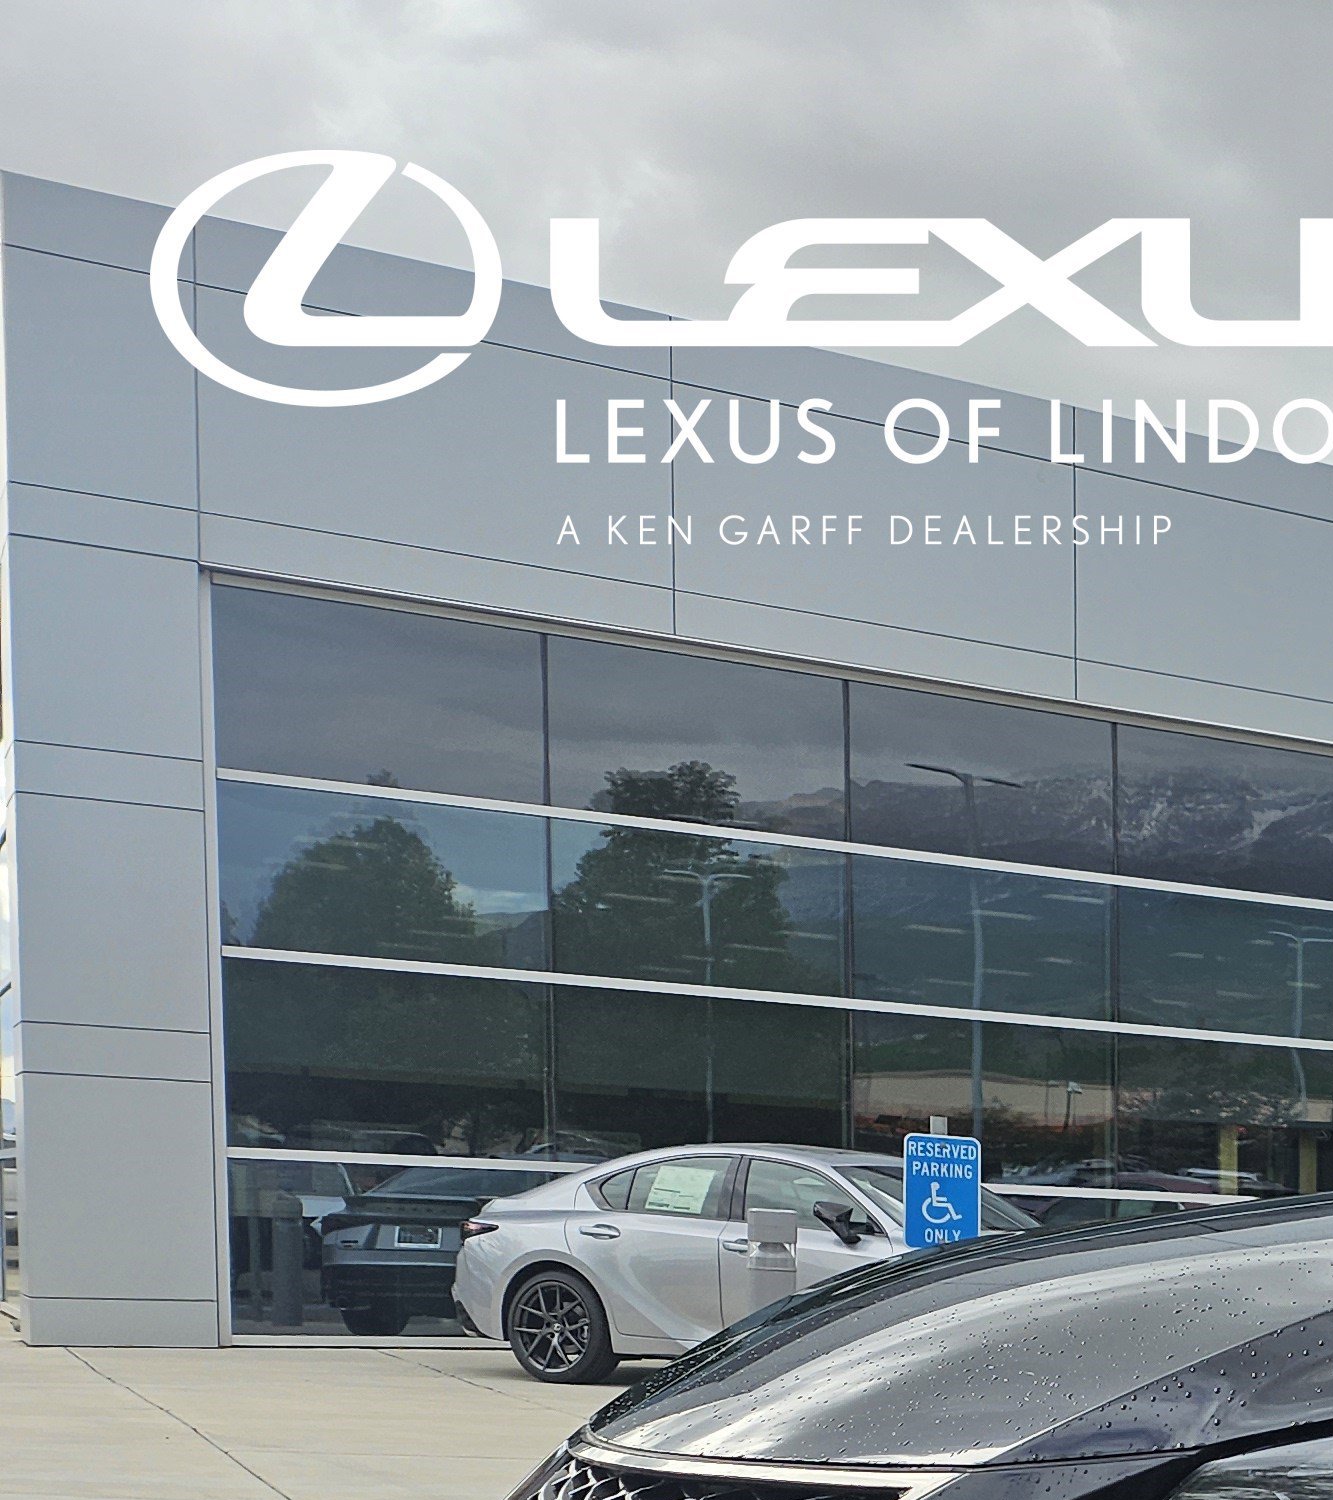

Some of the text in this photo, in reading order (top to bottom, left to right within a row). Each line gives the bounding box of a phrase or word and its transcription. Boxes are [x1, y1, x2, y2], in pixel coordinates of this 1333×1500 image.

[908, 1141, 976, 1160] RESERVED
[912, 1161, 973, 1179] PARKING
[924, 1228, 961, 1243] ONLY
